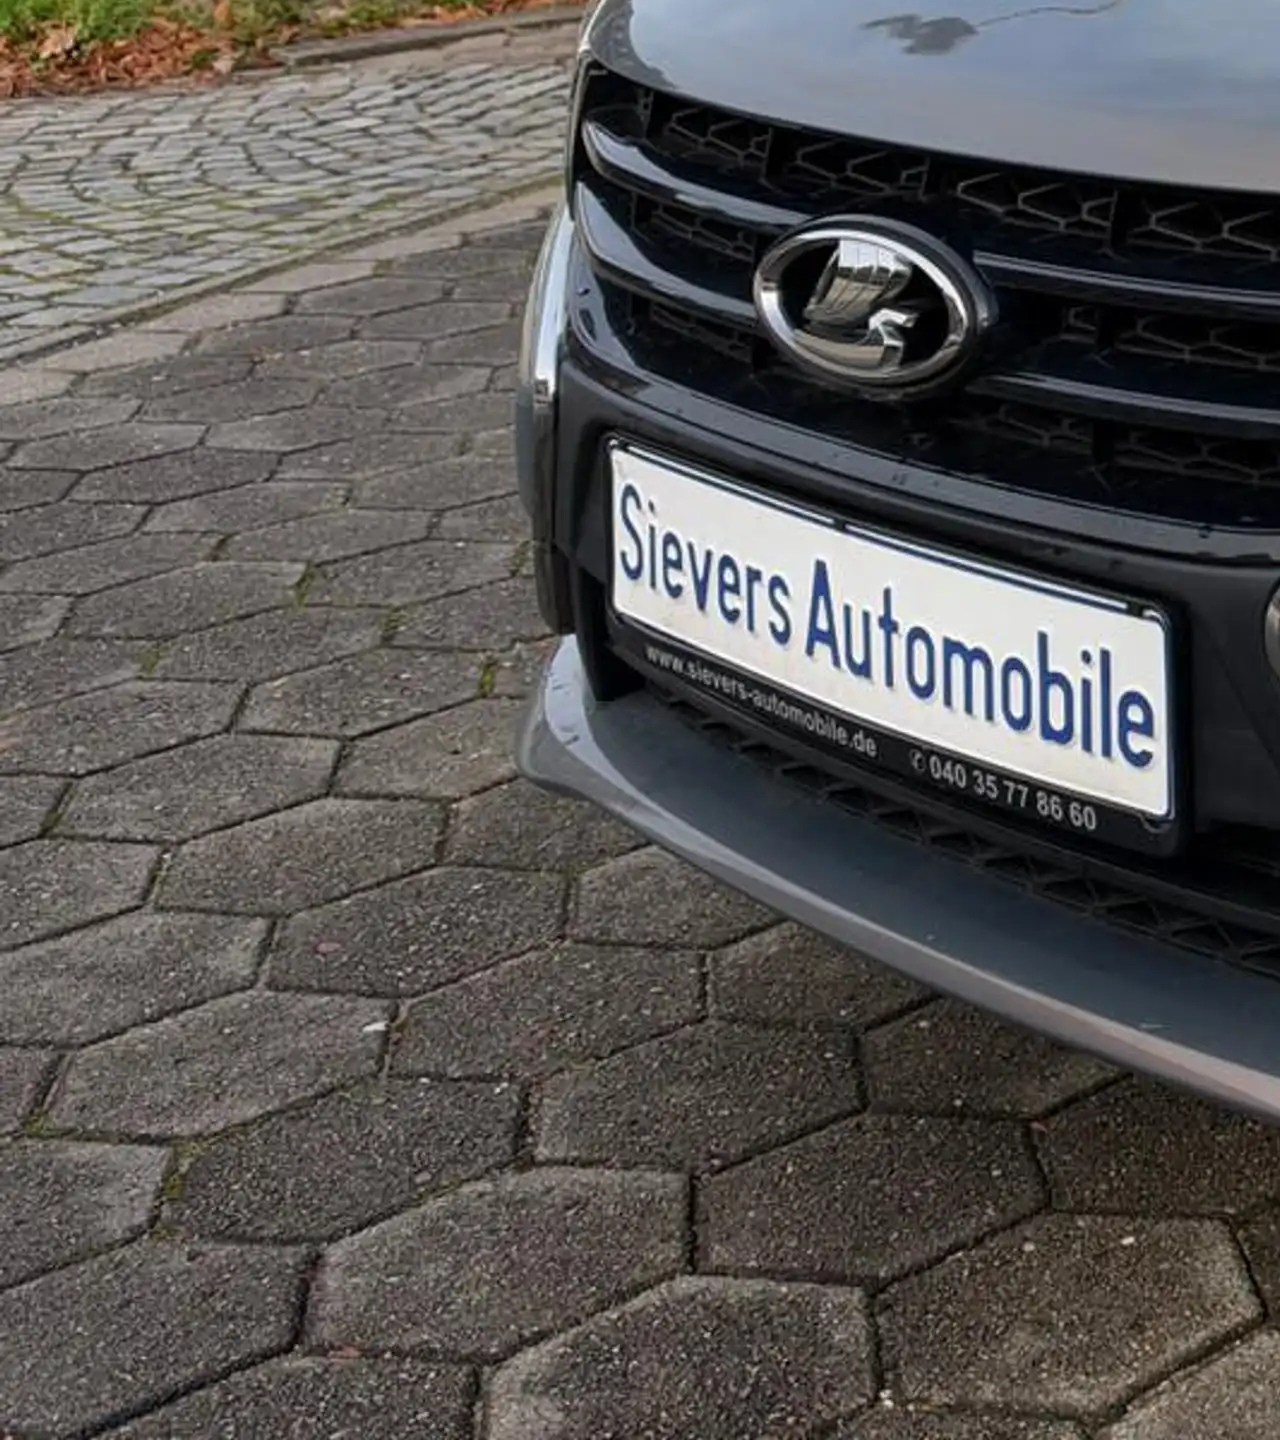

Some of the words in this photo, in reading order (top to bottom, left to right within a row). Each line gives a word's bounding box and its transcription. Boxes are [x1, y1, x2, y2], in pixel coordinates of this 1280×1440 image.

[619, 483, 792, 646] Sievers
[805, 559, 1155, 768] Automobile
[645, 644, 878, 758] www.sievers-automobile.de
[929, 755, 967, 789] 040
[972, 769, 999, 800] 35
[1002, 779, 1029, 808] 77
[1036, 790, 1064, 821] 86
[1069, 801, 1097, 831] 60
